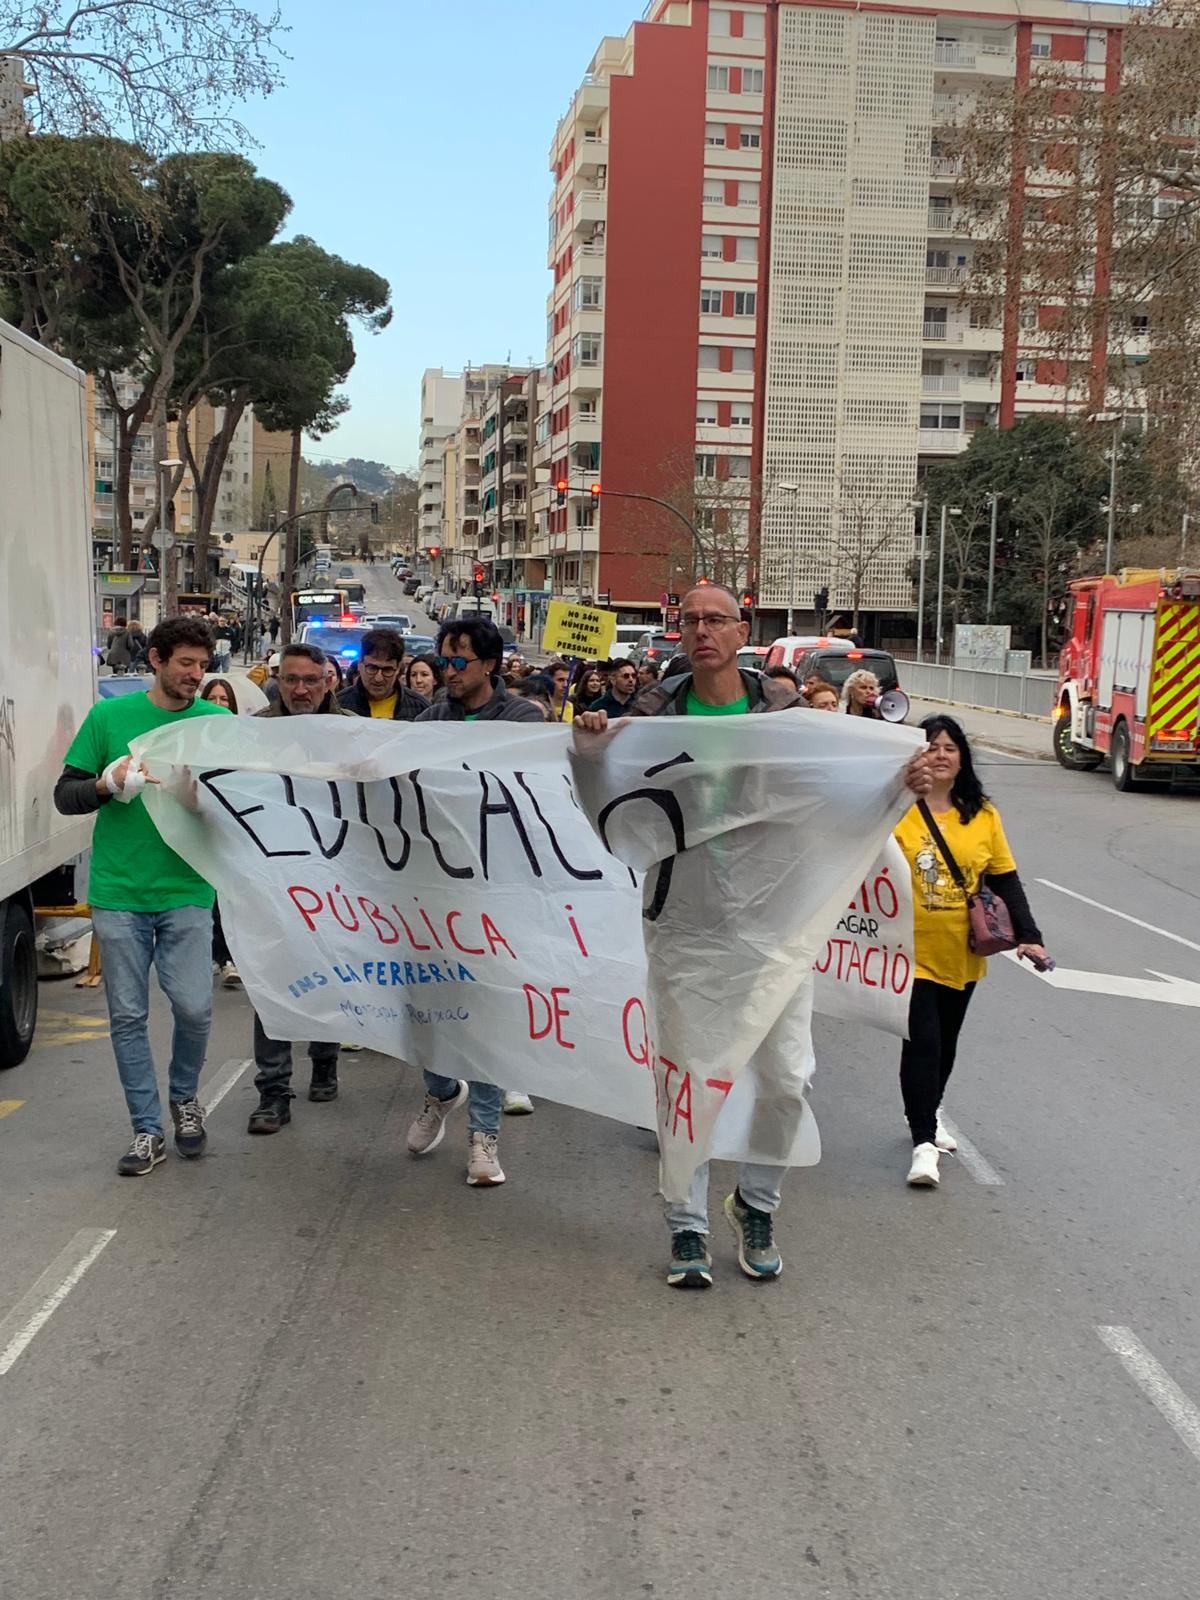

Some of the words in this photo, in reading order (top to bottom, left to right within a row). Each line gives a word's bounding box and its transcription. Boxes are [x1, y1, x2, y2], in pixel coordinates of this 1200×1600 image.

[567, 610, 579, 618] NO
[582, 612, 599, 622] SÓN
[571, 632, 588, 642] SÓN
[557, 640, 598, 655] PERSONES
[288, 972, 328, 998] INS
[333, 964, 362, 983] LA
[522, 983, 576, 1049] DE
